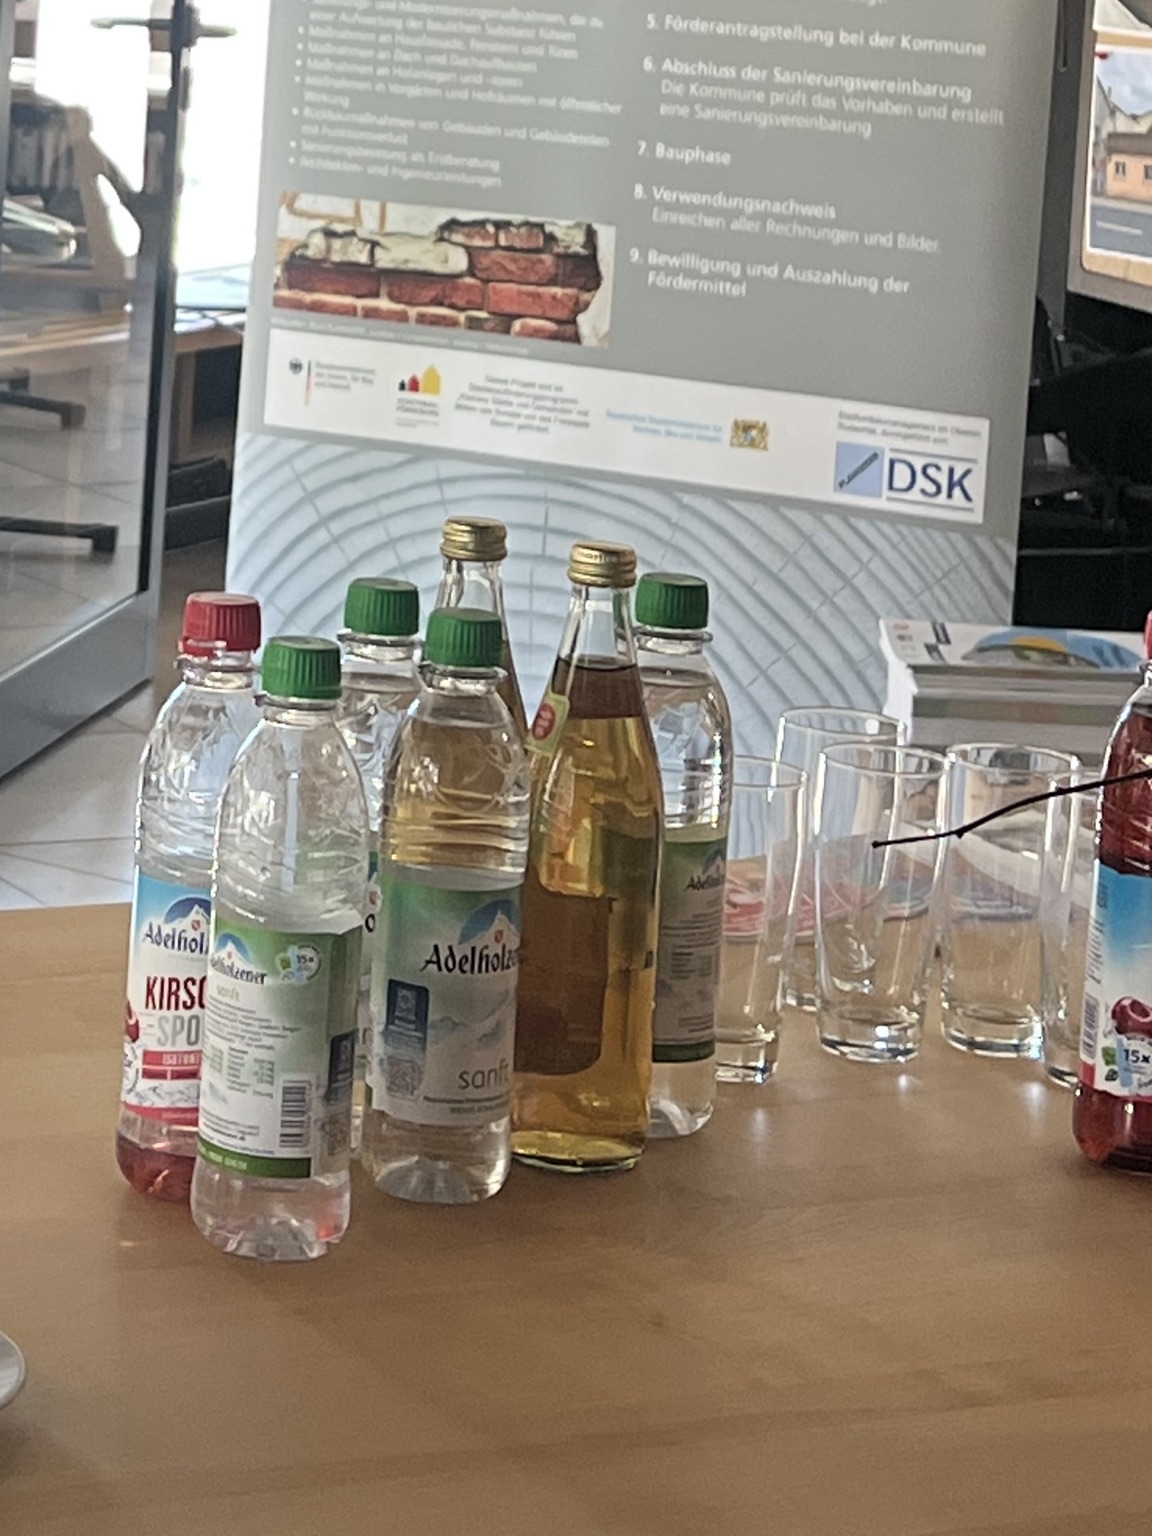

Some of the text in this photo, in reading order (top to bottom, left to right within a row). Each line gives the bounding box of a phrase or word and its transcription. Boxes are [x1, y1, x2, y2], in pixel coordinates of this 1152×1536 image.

[647, 13, 986, 56] 5. Förderantragstellung bei der Kommune
[643, 55, 972, 103] 6. Abschluss der Sanierungsvereinbarung
[660, 102, 689, 118] eine
[661, 79, 684, 97] Die
[689, 82, 765, 103] Kommune
[769, 88, 807, 108] prüft
[812, 93, 837, 110] das
[842, 95, 913, 116] Vorhaben
[917, 102, 947, 120] und
[656, 142, 731, 166] Bauphase
[634, 183, 836, 220] 8. Verwendungsnachweis
[652, 207, 725, 228] Einreichen
[730, 216, 762, 232] aller
[766, 218, 859, 245] Rechnungen
[864, 231, 893, 248] und
[629, 247, 909, 294] 9. Bewilligung und Auszahlung der
[648, 271, 747, 297] Fördermittel
[886, 456, 974, 504] DSK
[144, 921, 208, 954] Adelhol
[421, 943, 522, 975] Adelholz
[1123, 1049, 1150, 1063] 15x
